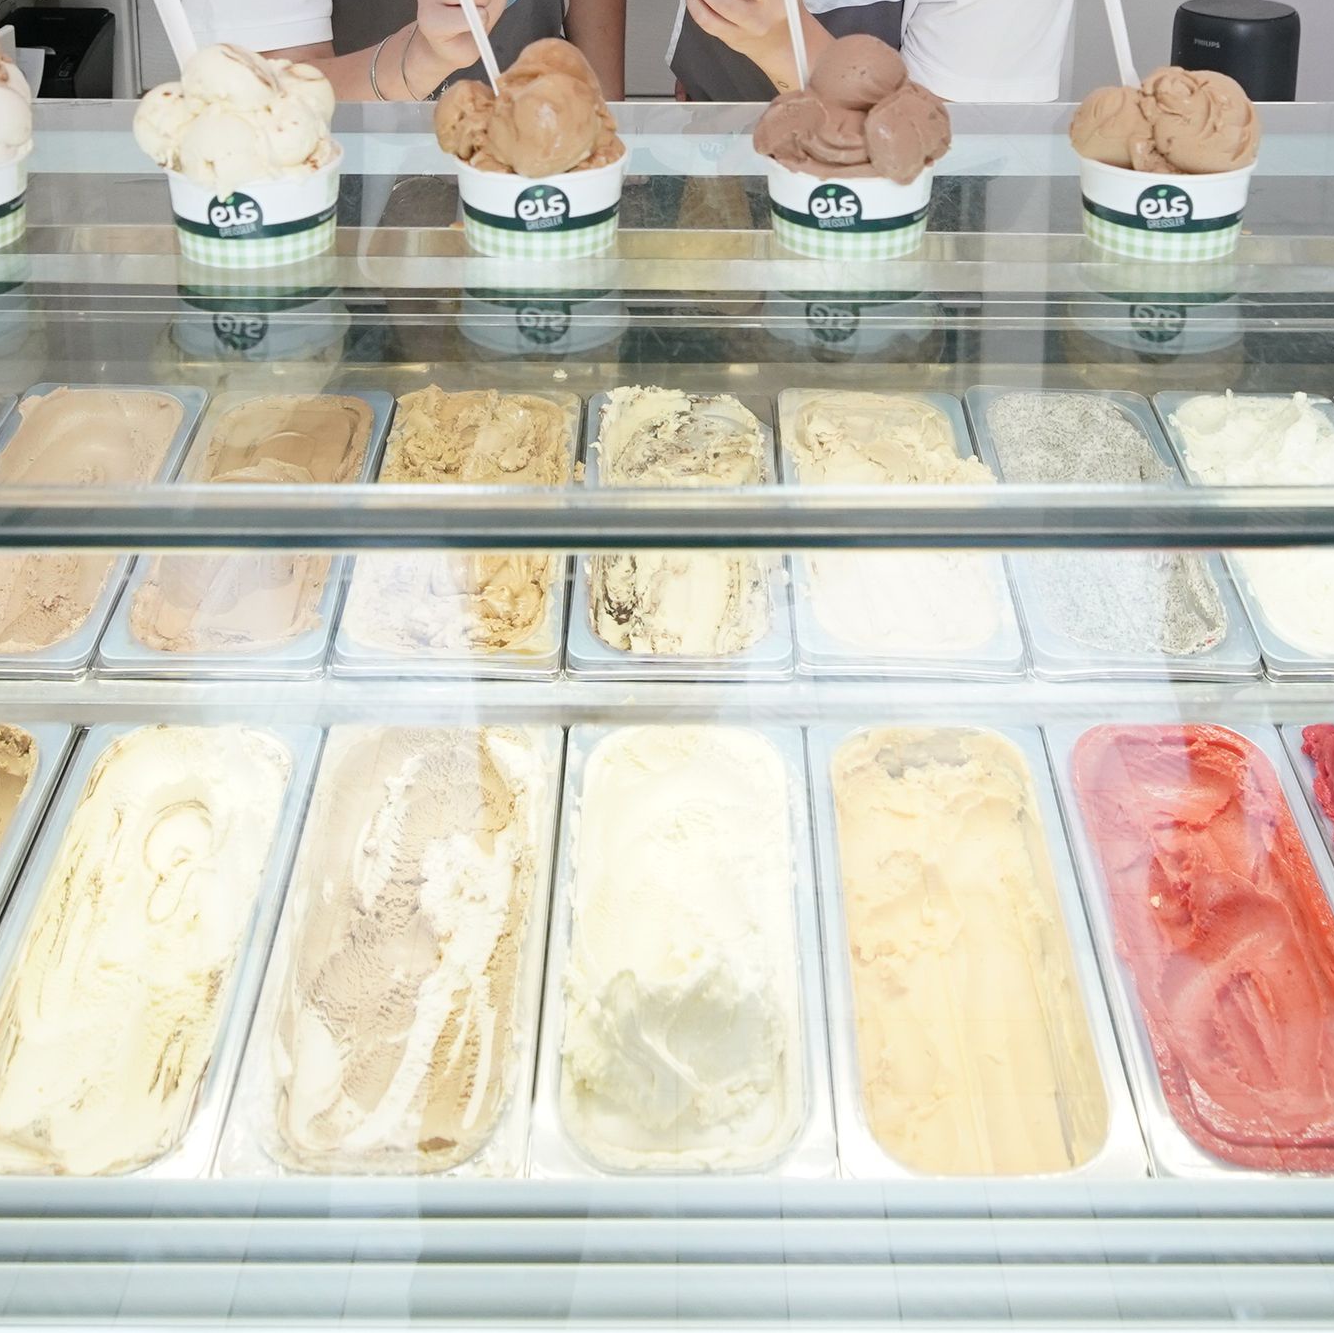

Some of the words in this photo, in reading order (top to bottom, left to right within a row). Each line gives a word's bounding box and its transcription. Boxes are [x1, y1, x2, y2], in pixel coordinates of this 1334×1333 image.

[1194, 38, 1221, 49] PHILIPS
[210, 196, 259, 228] eis
[517, 189, 567, 222] eis
[810, 188, 859, 220] eis
[1139, 189, 1189, 220] eis
[818, 216, 856, 229] GREISSLER
